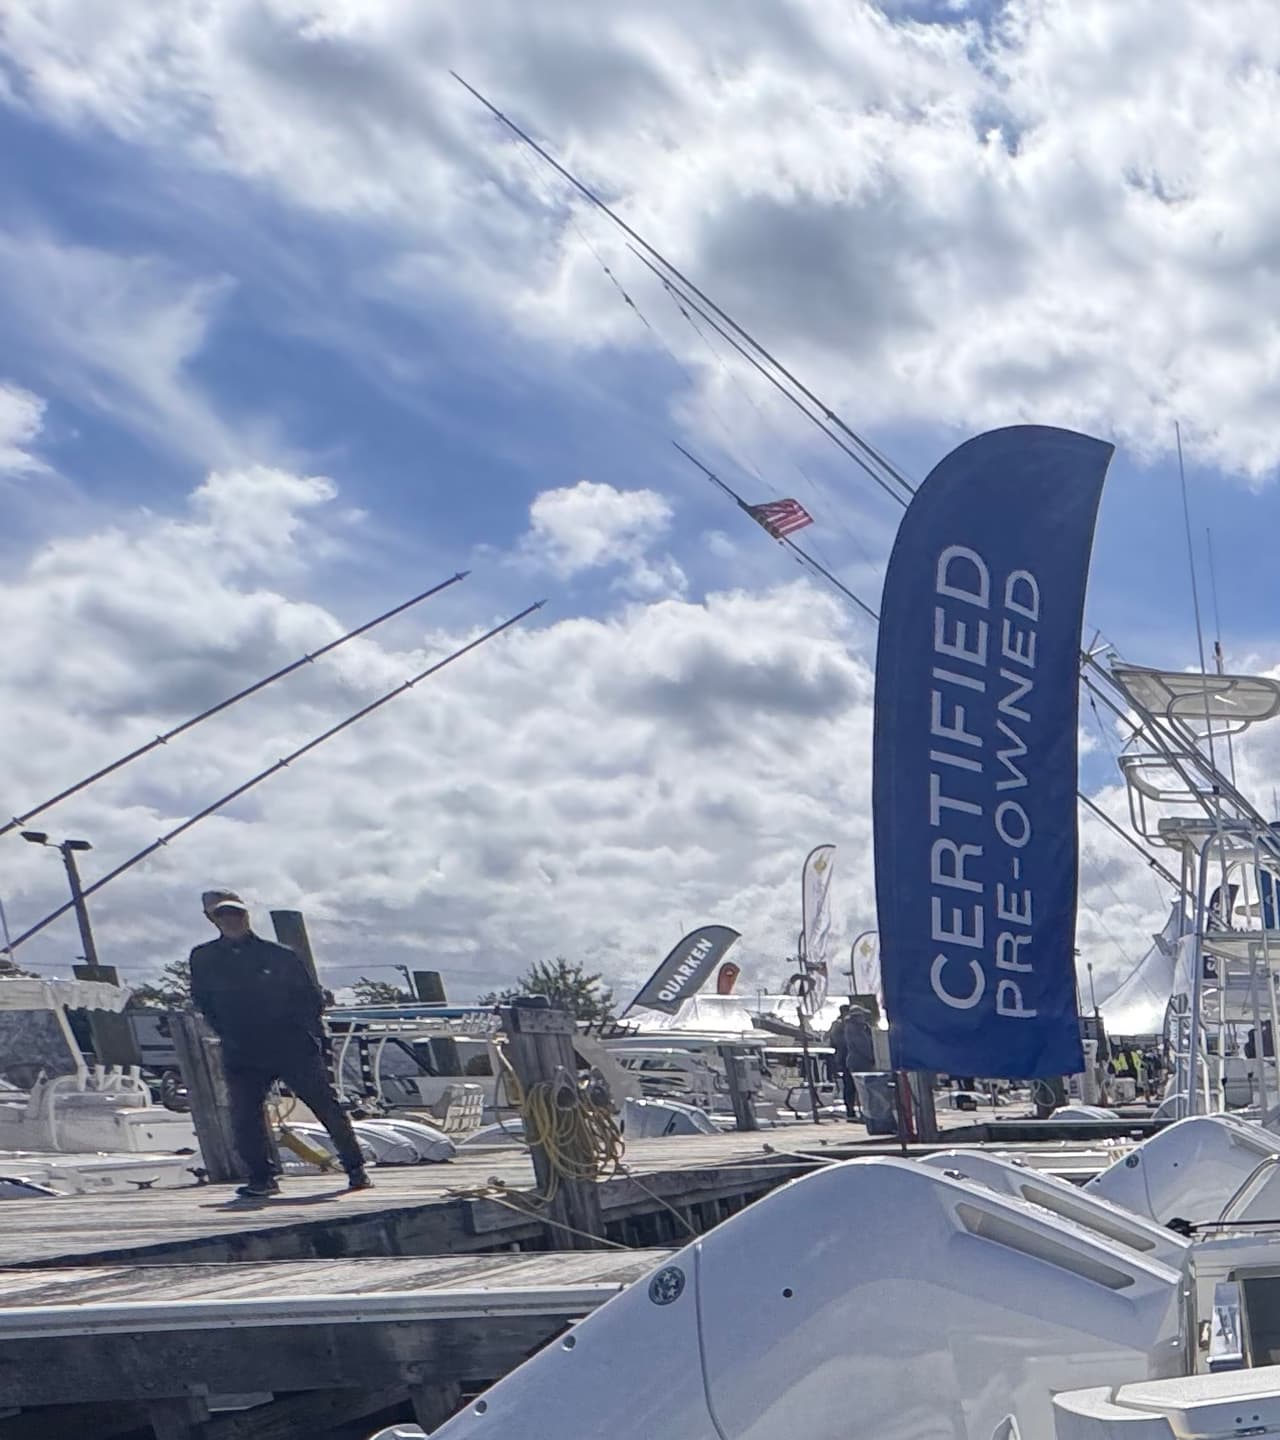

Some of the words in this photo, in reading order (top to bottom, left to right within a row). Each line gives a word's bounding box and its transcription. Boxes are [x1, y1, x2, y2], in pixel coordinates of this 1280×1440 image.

[657, 938, 713, 1002] QUARKEN
[930, 543, 992, 1010] CERTIFIED
[995, 569, 1041, 1019] PRE-OWNED
